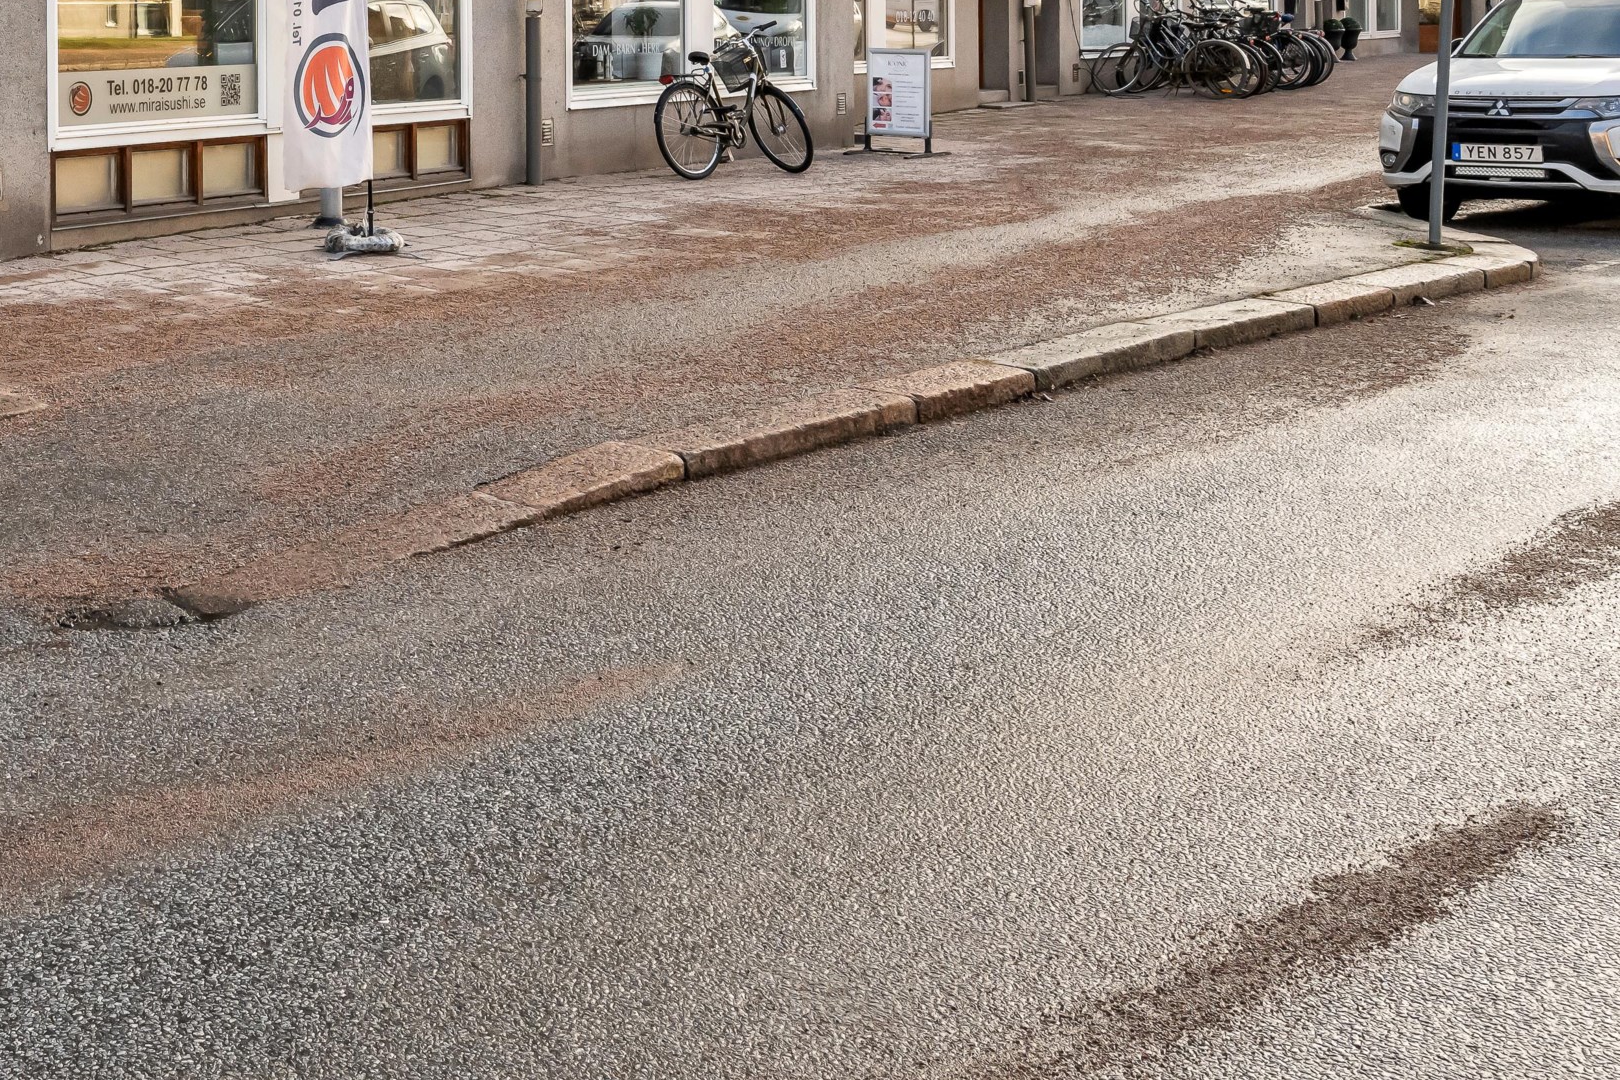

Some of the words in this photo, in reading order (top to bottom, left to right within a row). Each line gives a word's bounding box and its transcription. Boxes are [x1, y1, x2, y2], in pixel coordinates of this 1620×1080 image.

[107, 79, 129, 96] Tel.
[133, 77, 173, 95] 018-20
[176, 76, 191, 92] 77
[194, 75, 208, 91] 78
[109, 95, 206, 114] www.miraisushi.se
[1466, 145, 1497, 159] YEN
[1502, 147, 1535, 161] 857
